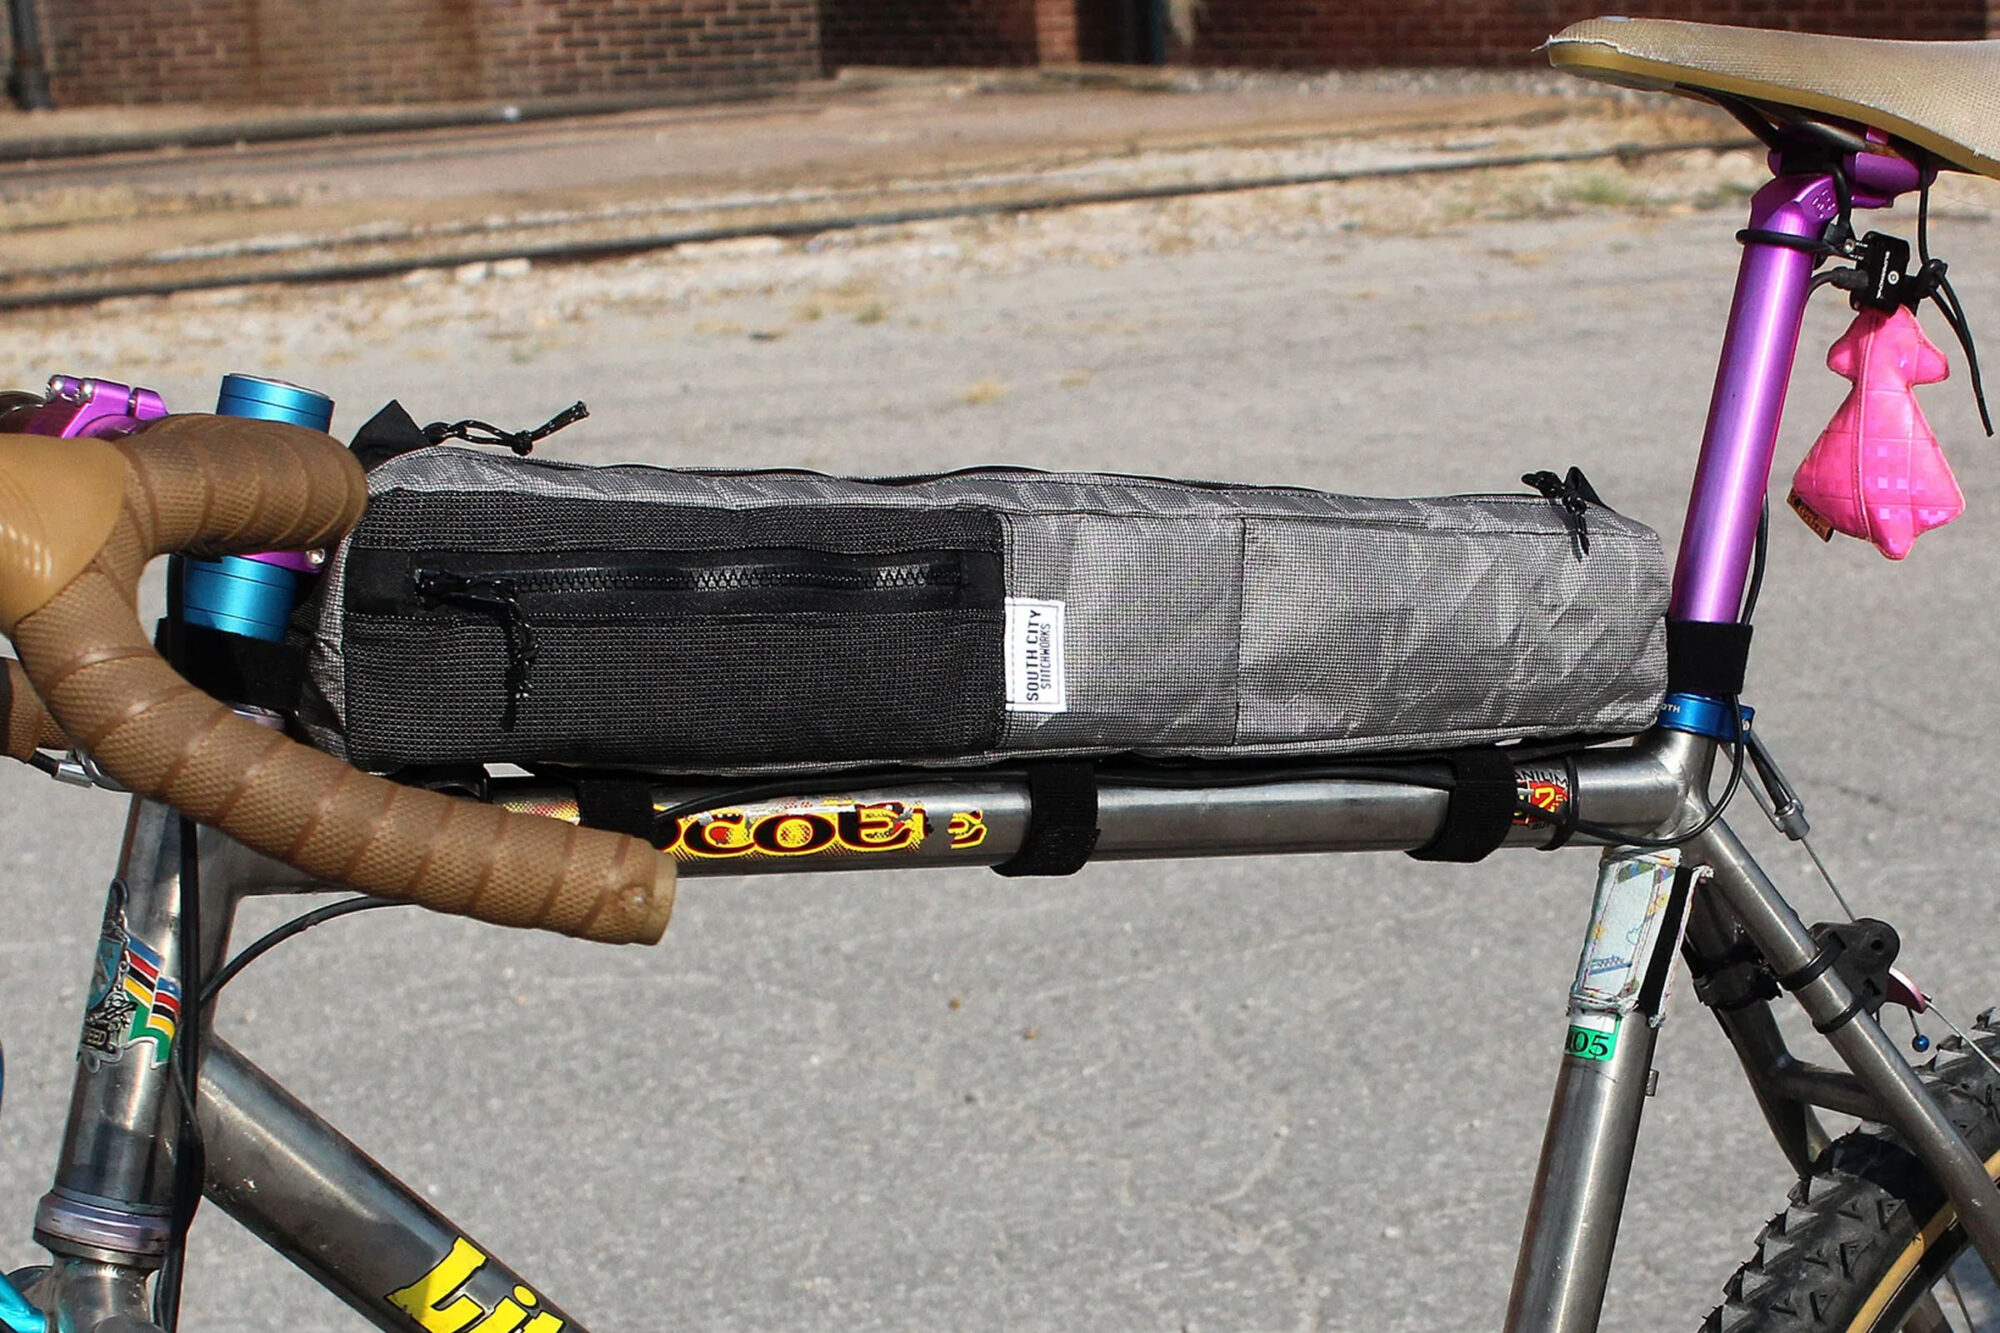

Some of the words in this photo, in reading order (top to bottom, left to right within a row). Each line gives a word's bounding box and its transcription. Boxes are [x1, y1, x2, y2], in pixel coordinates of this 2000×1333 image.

[1026, 609, 1042, 645] CITY
[1039, 623, 1052, 690] STITCHWORKS
[1026, 649, 1040, 701] SOUTH
[1660, 703, 1681, 713] OTH
[1514, 769, 1568, 786] ANIUM
